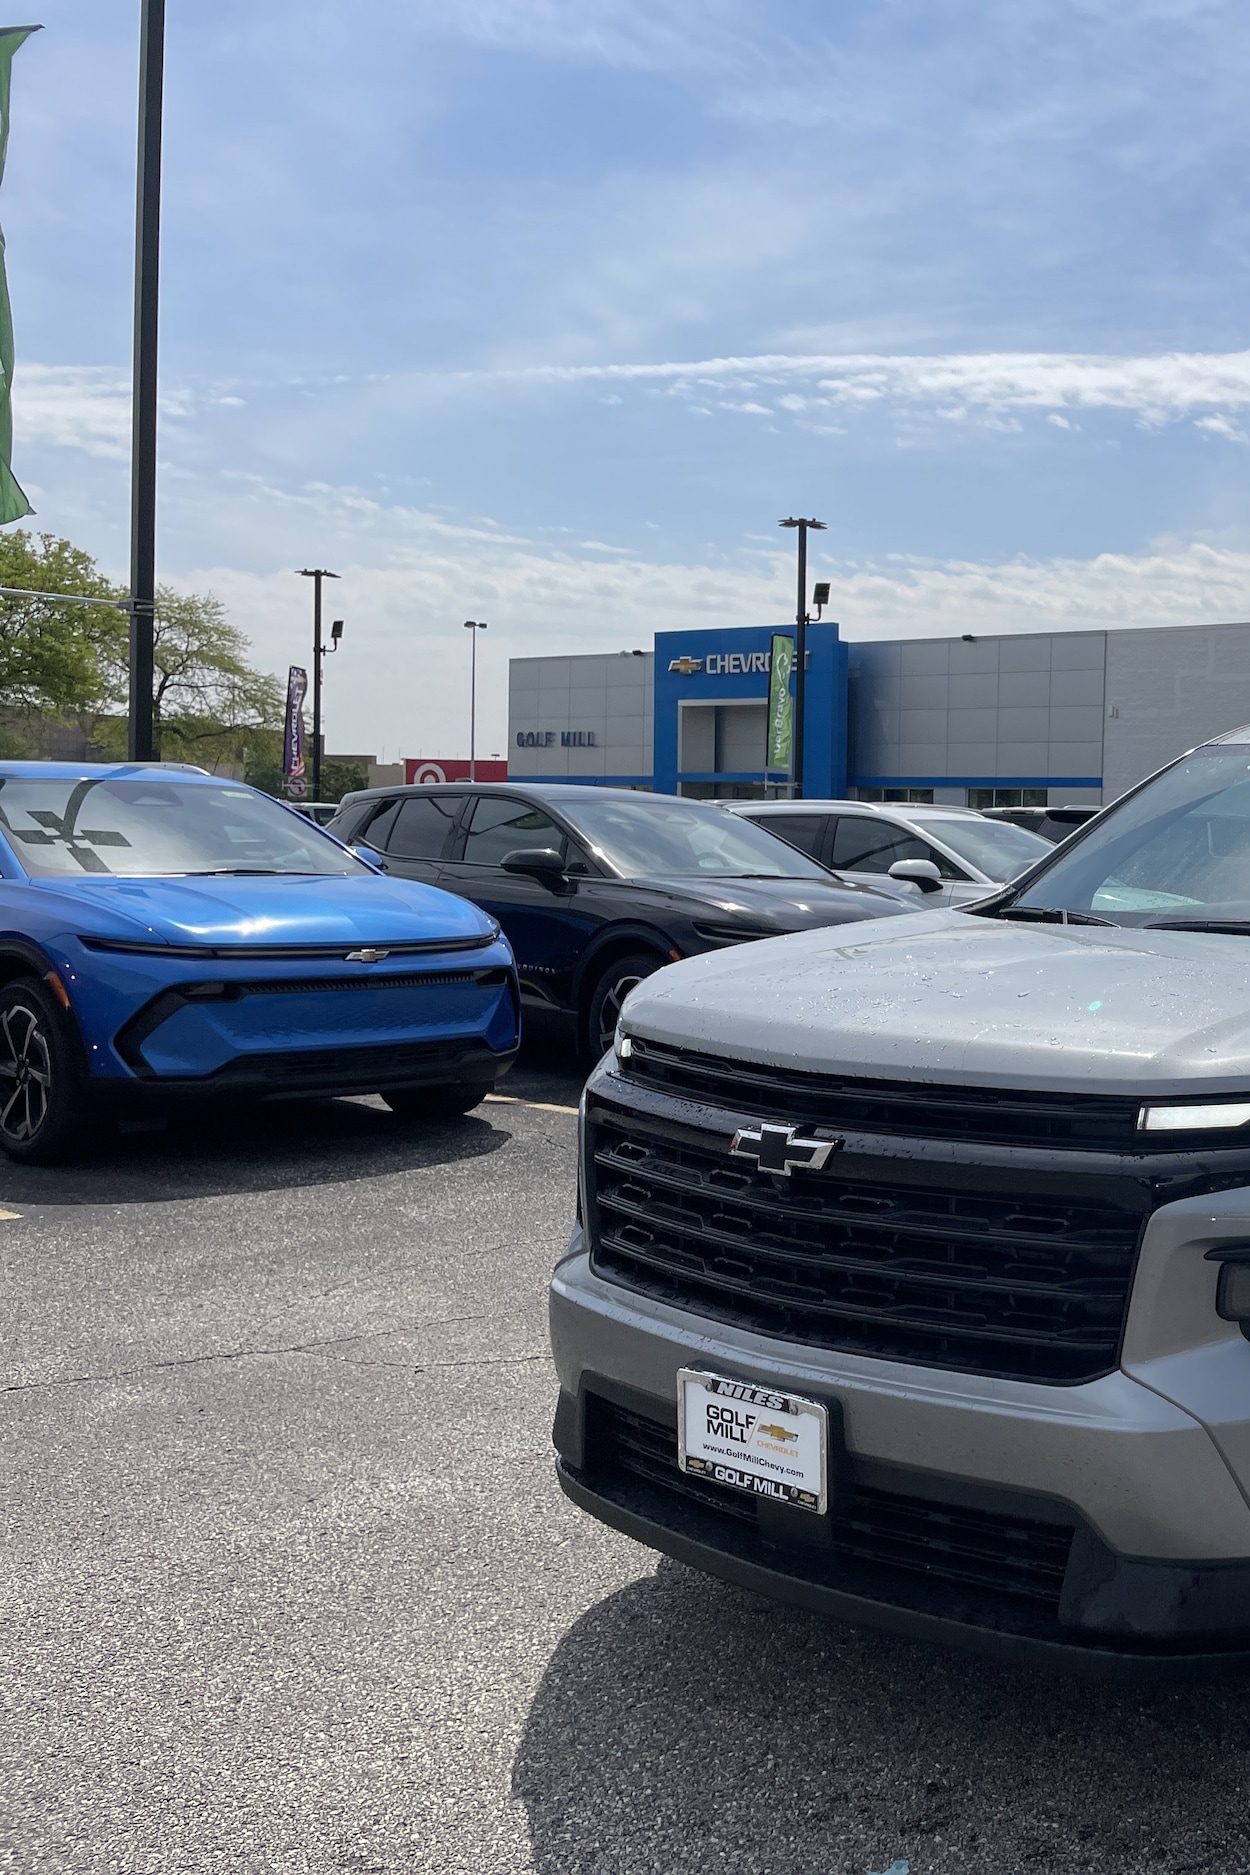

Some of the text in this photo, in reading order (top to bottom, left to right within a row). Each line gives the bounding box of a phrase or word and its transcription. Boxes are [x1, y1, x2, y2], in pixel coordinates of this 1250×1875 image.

[290, 687, 304, 771] CHEVROLET
[516, 731, 596, 748] GOLF MILL
[717, 1381, 785, 1410] NILES
[706, 1403, 757, 1429] GOLF
[706, 1418, 747, 1444] MILL
[702, 1443, 805, 1479] www.GolfMillChevy.com
[756, 1440, 800, 1458] CHEVROLET
[714, 1465, 789, 1501] GOLF MILL
